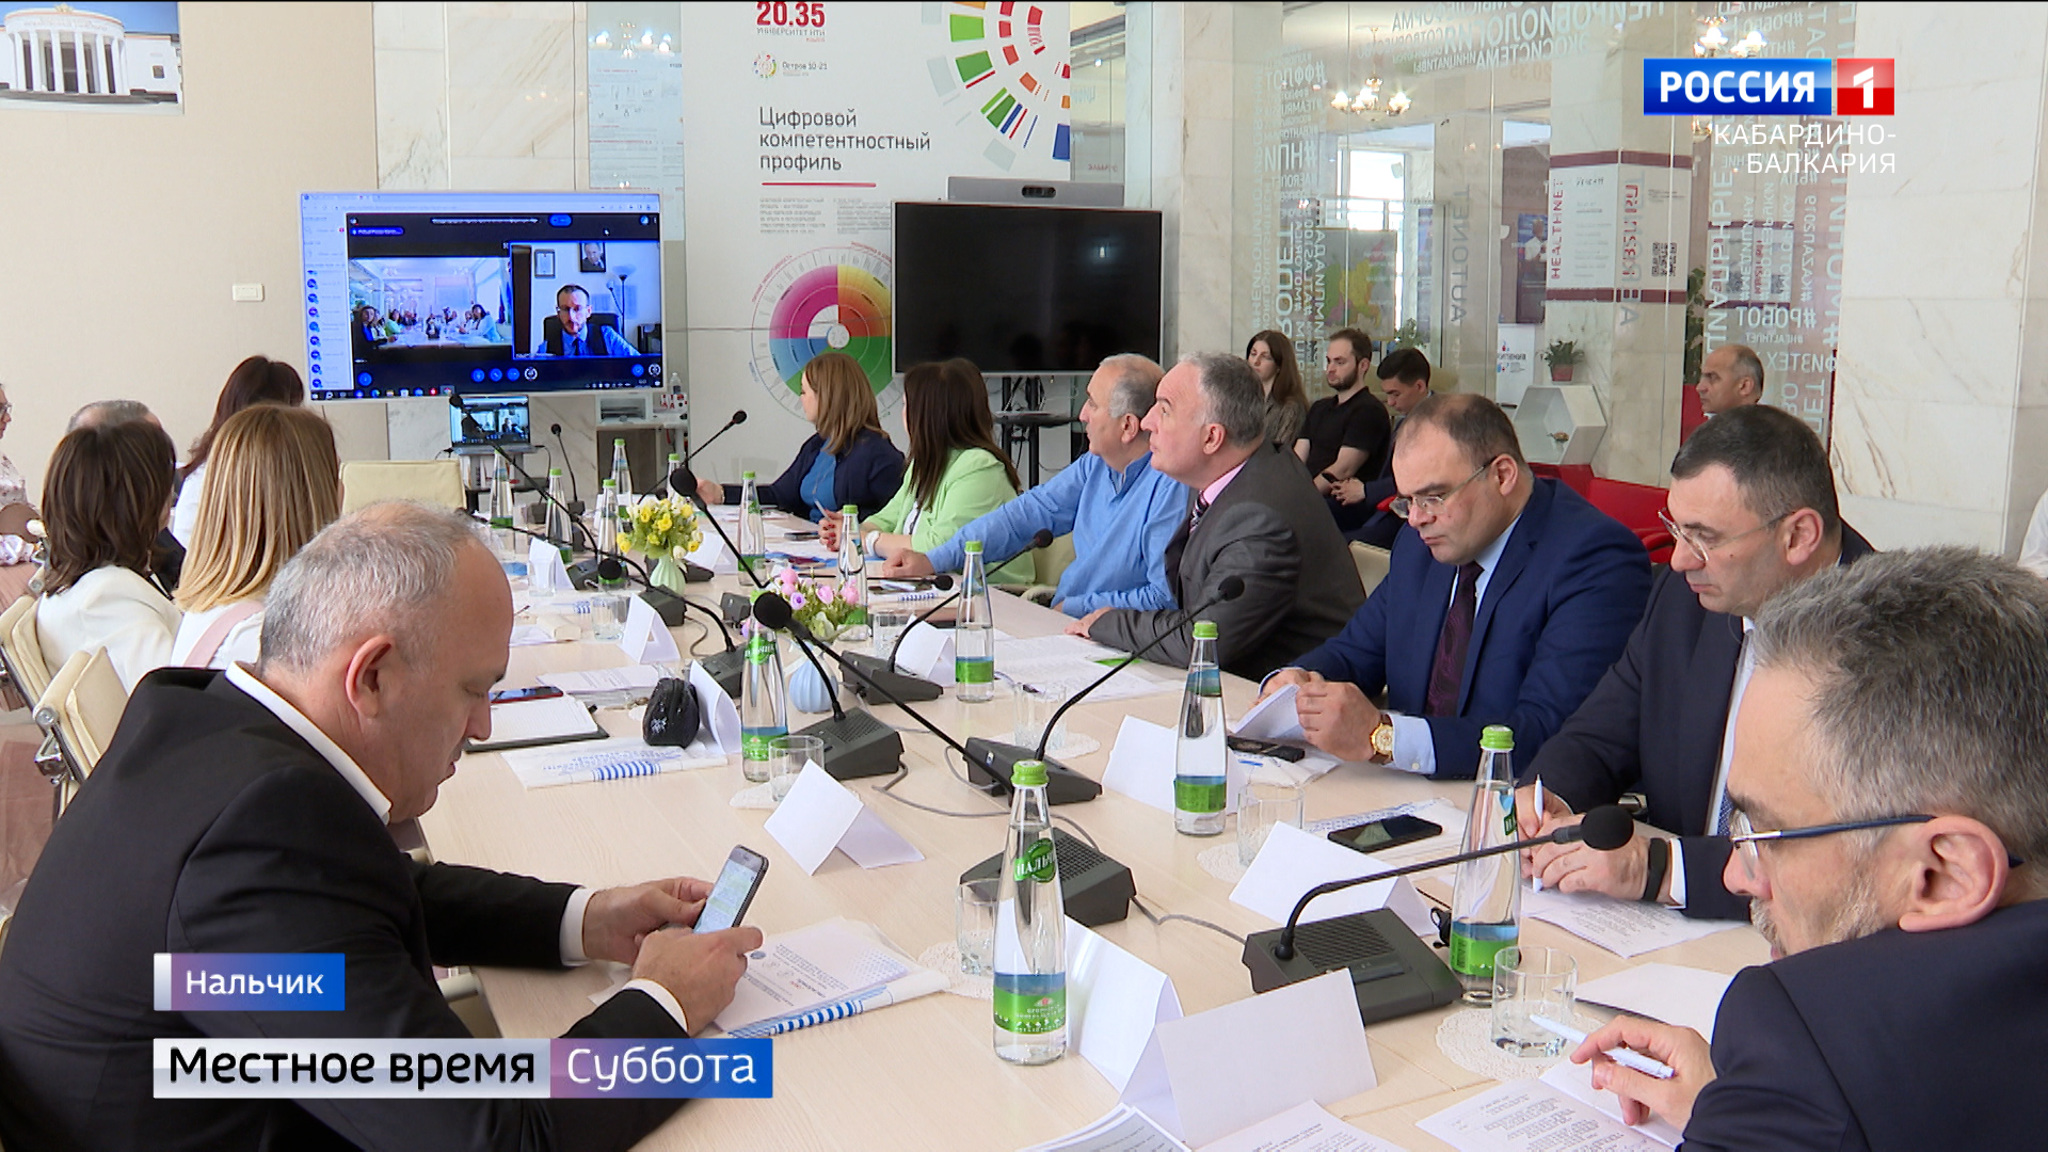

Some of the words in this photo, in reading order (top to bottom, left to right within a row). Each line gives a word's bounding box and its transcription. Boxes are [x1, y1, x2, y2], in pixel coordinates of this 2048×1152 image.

[756, 2, 826, 27] 20.35
[760, 106, 857, 130] Цифровой
[760, 132, 931, 151] компетентностный
[760, 154, 842, 173] профиль
